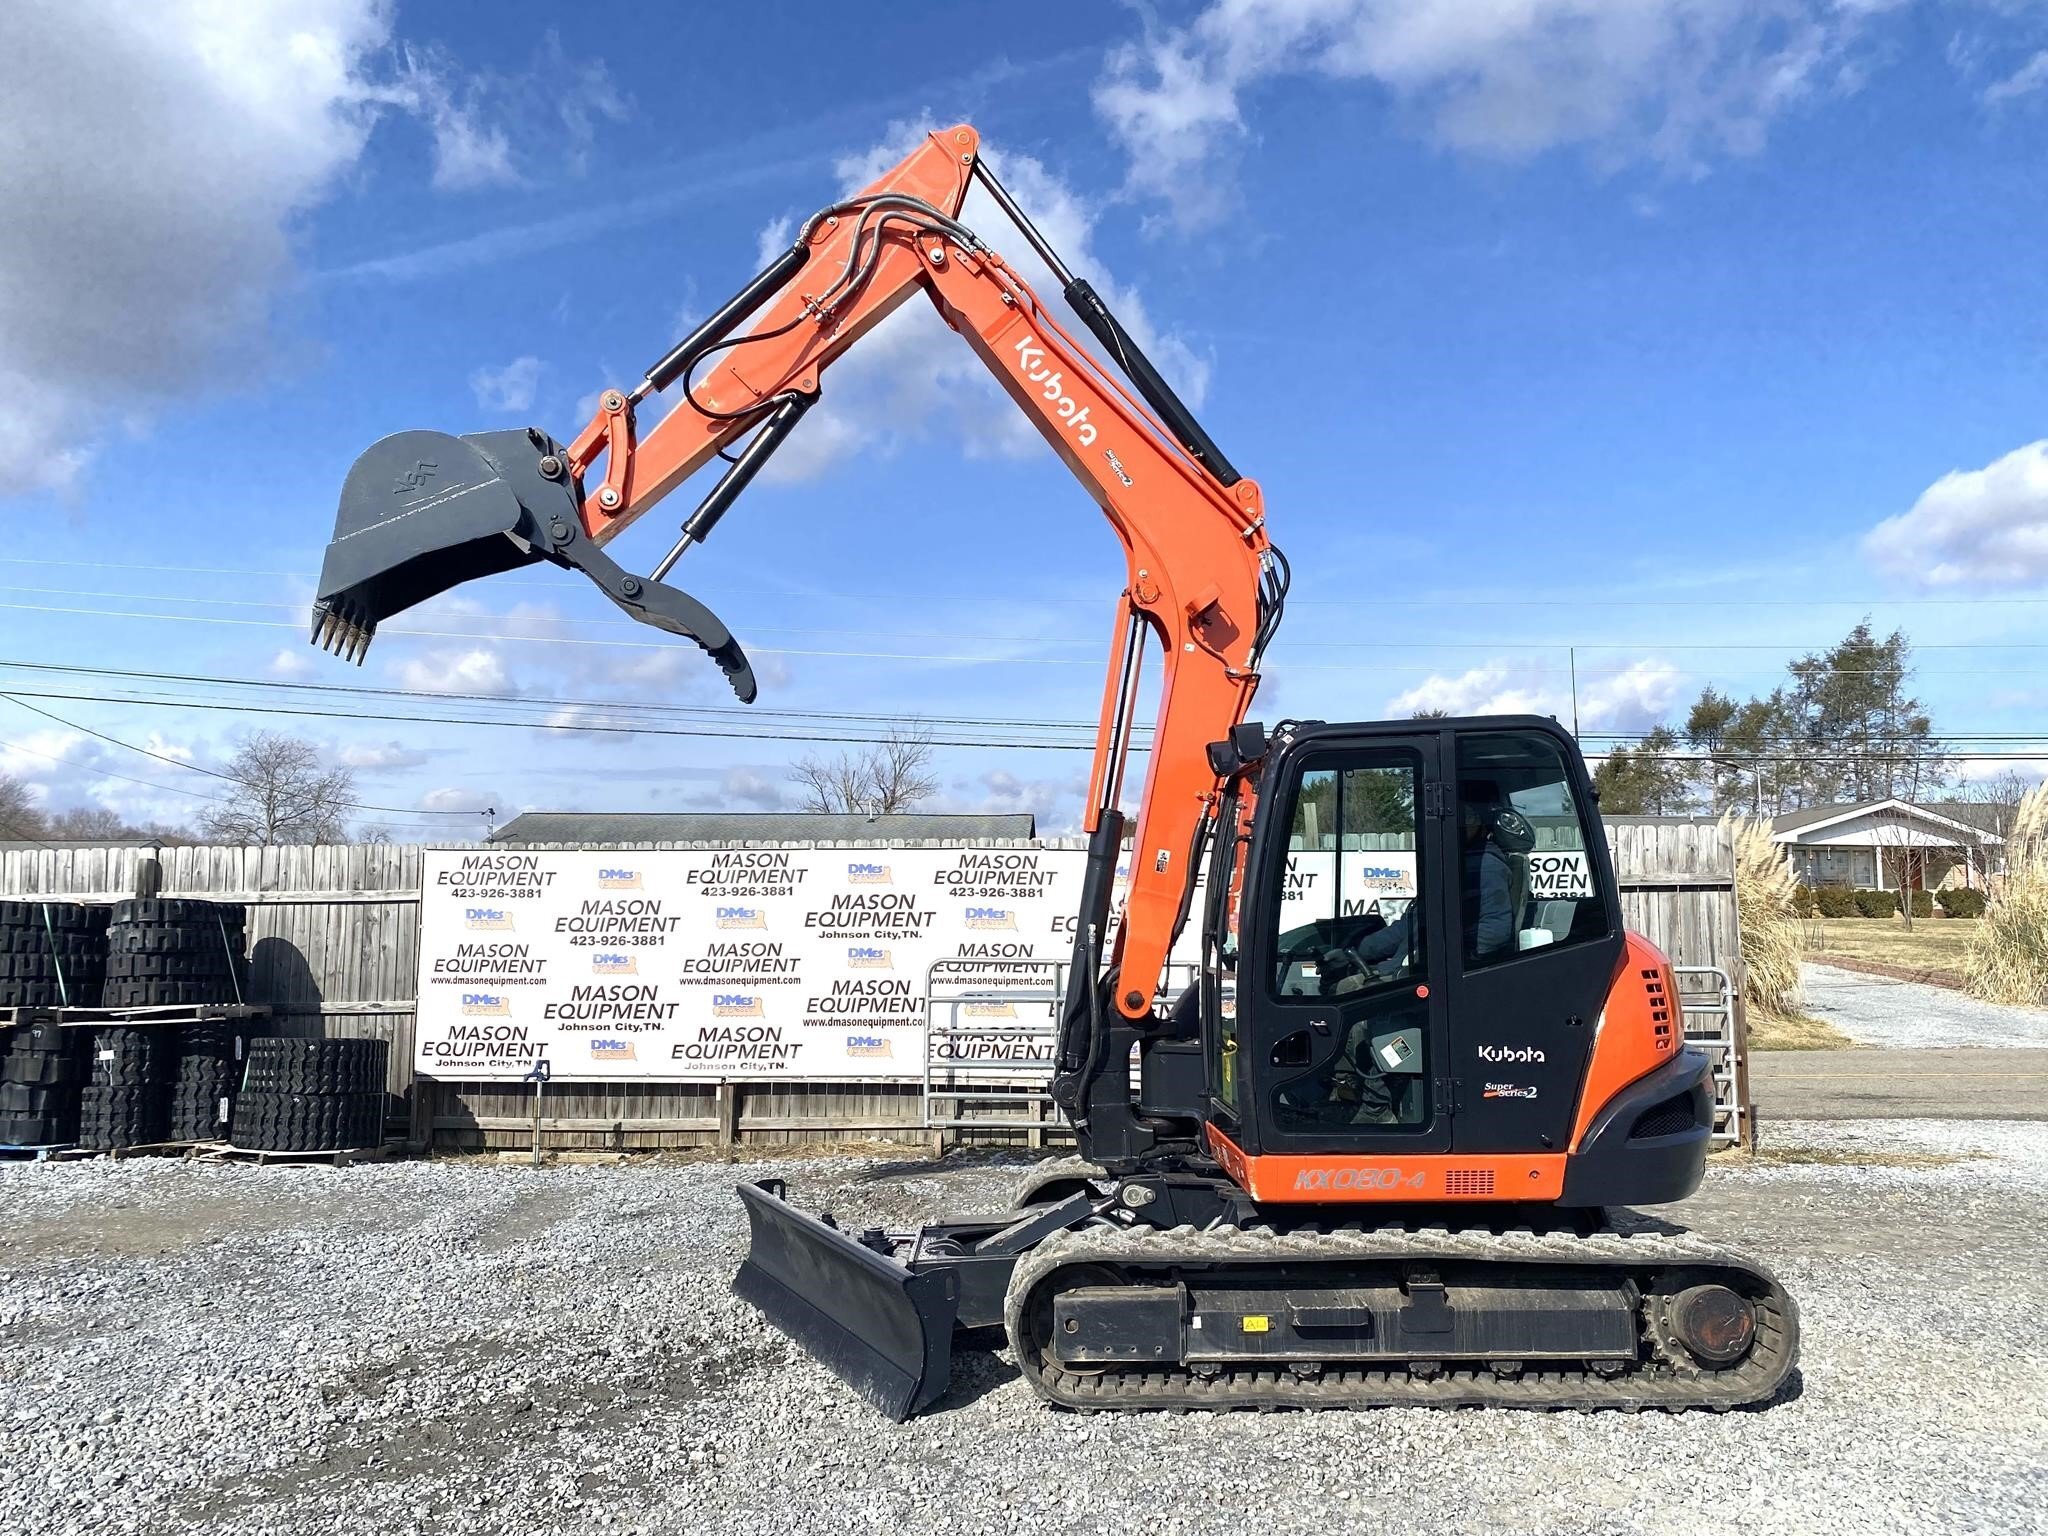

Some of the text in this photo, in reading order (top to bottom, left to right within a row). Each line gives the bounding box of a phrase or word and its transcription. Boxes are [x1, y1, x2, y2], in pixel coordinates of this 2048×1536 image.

[1014, 336, 1097, 447] Kubota
[462, 856, 538, 870] MASON
[711, 853, 789, 868] MASON
[958, 855, 1038, 869] MASON
[1529, 857, 1579, 872] SON
[437, 872, 556, 886] EQUIPMENT
[686, 869, 808, 884] EQUIPMENT
[934, 871, 1058, 885] EQUIPMENT
[451, 889, 541, 898] 423-926-3881
[701, 887, 793, 896] 423-926-3881
[949, 887, 1043, 898] 423-926-3881
[580, 900, 661, 914] MASON
[831, 894, 916, 909] MASON
[554, 917, 681, 932] EQUIPMENT
[804, 912, 936, 927] EQUIPMENT
[570, 936, 664, 946] 423-926-3881
[818, 931, 870, 939] Johnson
[456, 944, 529, 957] MASON
[707, 943, 782, 957] MASON
[957, 943, 1033, 957] MASON
[434, 959, 547, 973] EQUIPMENT
[683, 958, 800, 973] EQUIPMENT
[431, 976, 546, 986] www.dmasonequipment.com
[680, 976, 800, 986] www.dmasonequipment.com
[831, 980, 911, 995] MASON
[931, 976, 1053, 986] www.dmasonequipment.com
[571, 986, 658, 1001] MASON
[544, 1004, 679, 1019] EQUIPMENT
[806, 998, 925, 1013] EQUIPMENT
[558, 1023, 610, 1031] Johnson
[803, 1017, 925, 1029] www.dmasonequipment.co
[448, 1026, 527, 1040] MASON
[698, 1027, 782, 1042] MASON
[422, 1042, 548, 1057] EQUIPMENT
[671, 1044, 803, 1059] EQUIPMENT
[1478, 1045, 1545, 1062] Kubota
[1484, 1083, 1514, 1091] Super
[1294, 1168, 1425, 1190] KX080-4
